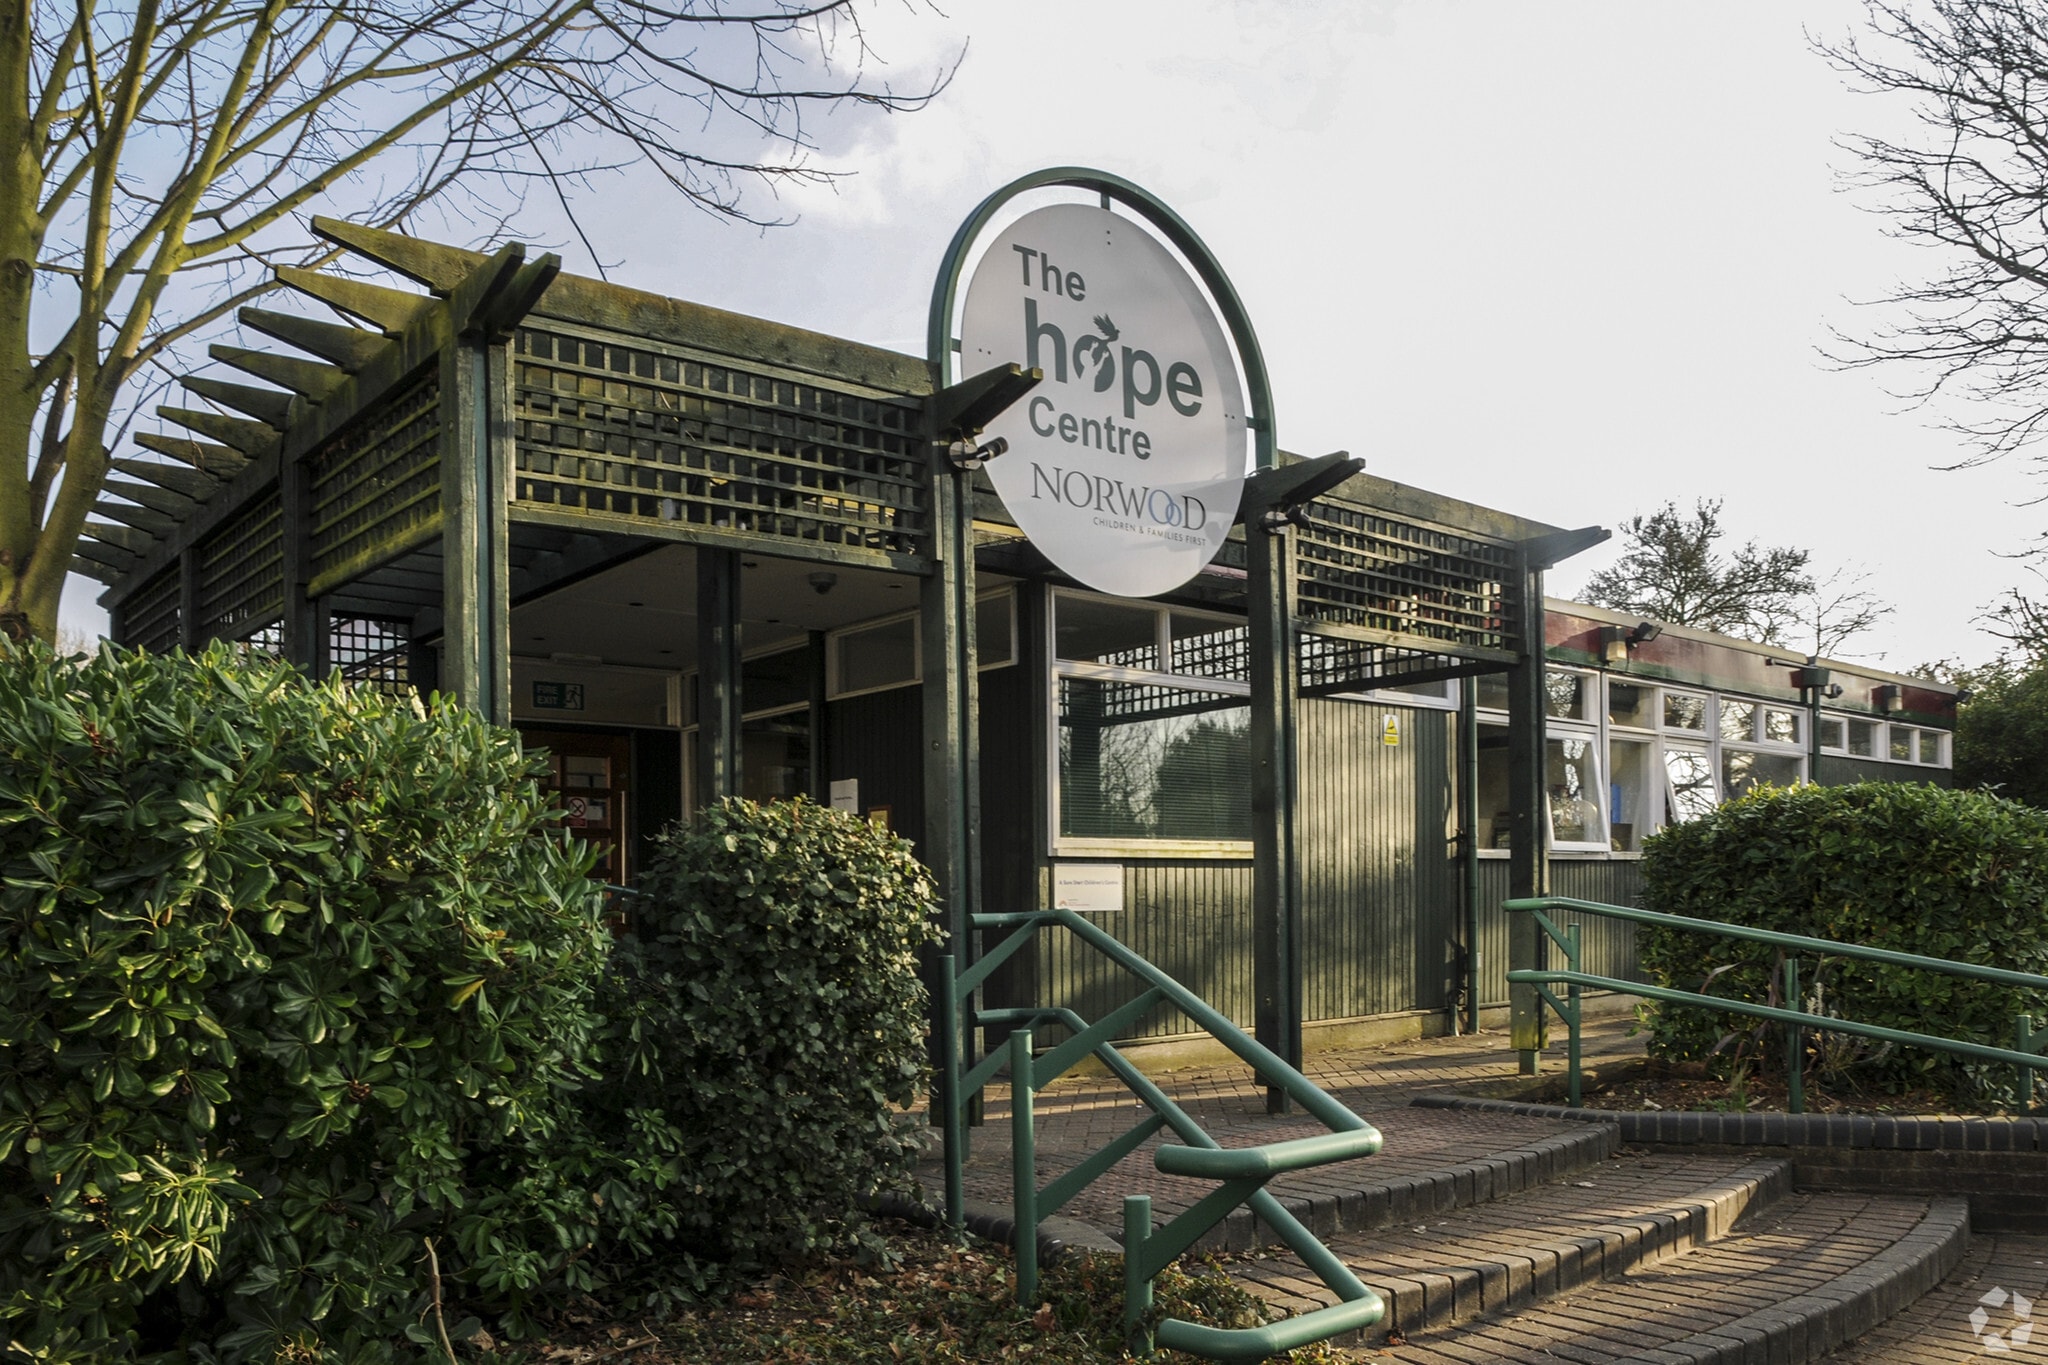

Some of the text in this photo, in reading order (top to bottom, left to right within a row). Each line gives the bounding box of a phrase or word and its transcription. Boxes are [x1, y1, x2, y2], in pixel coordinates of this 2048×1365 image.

[1013, 244, 1086, 302] The
[1024, 297, 1204, 420] hope
[1028, 396, 1152, 461] Centre
[1030, 462, 1207, 531] NORWOOD
[1093, 516, 1207, 546] CHILDREN & FAMILIES FIRST
[537, 695, 558, 705] EXIT
